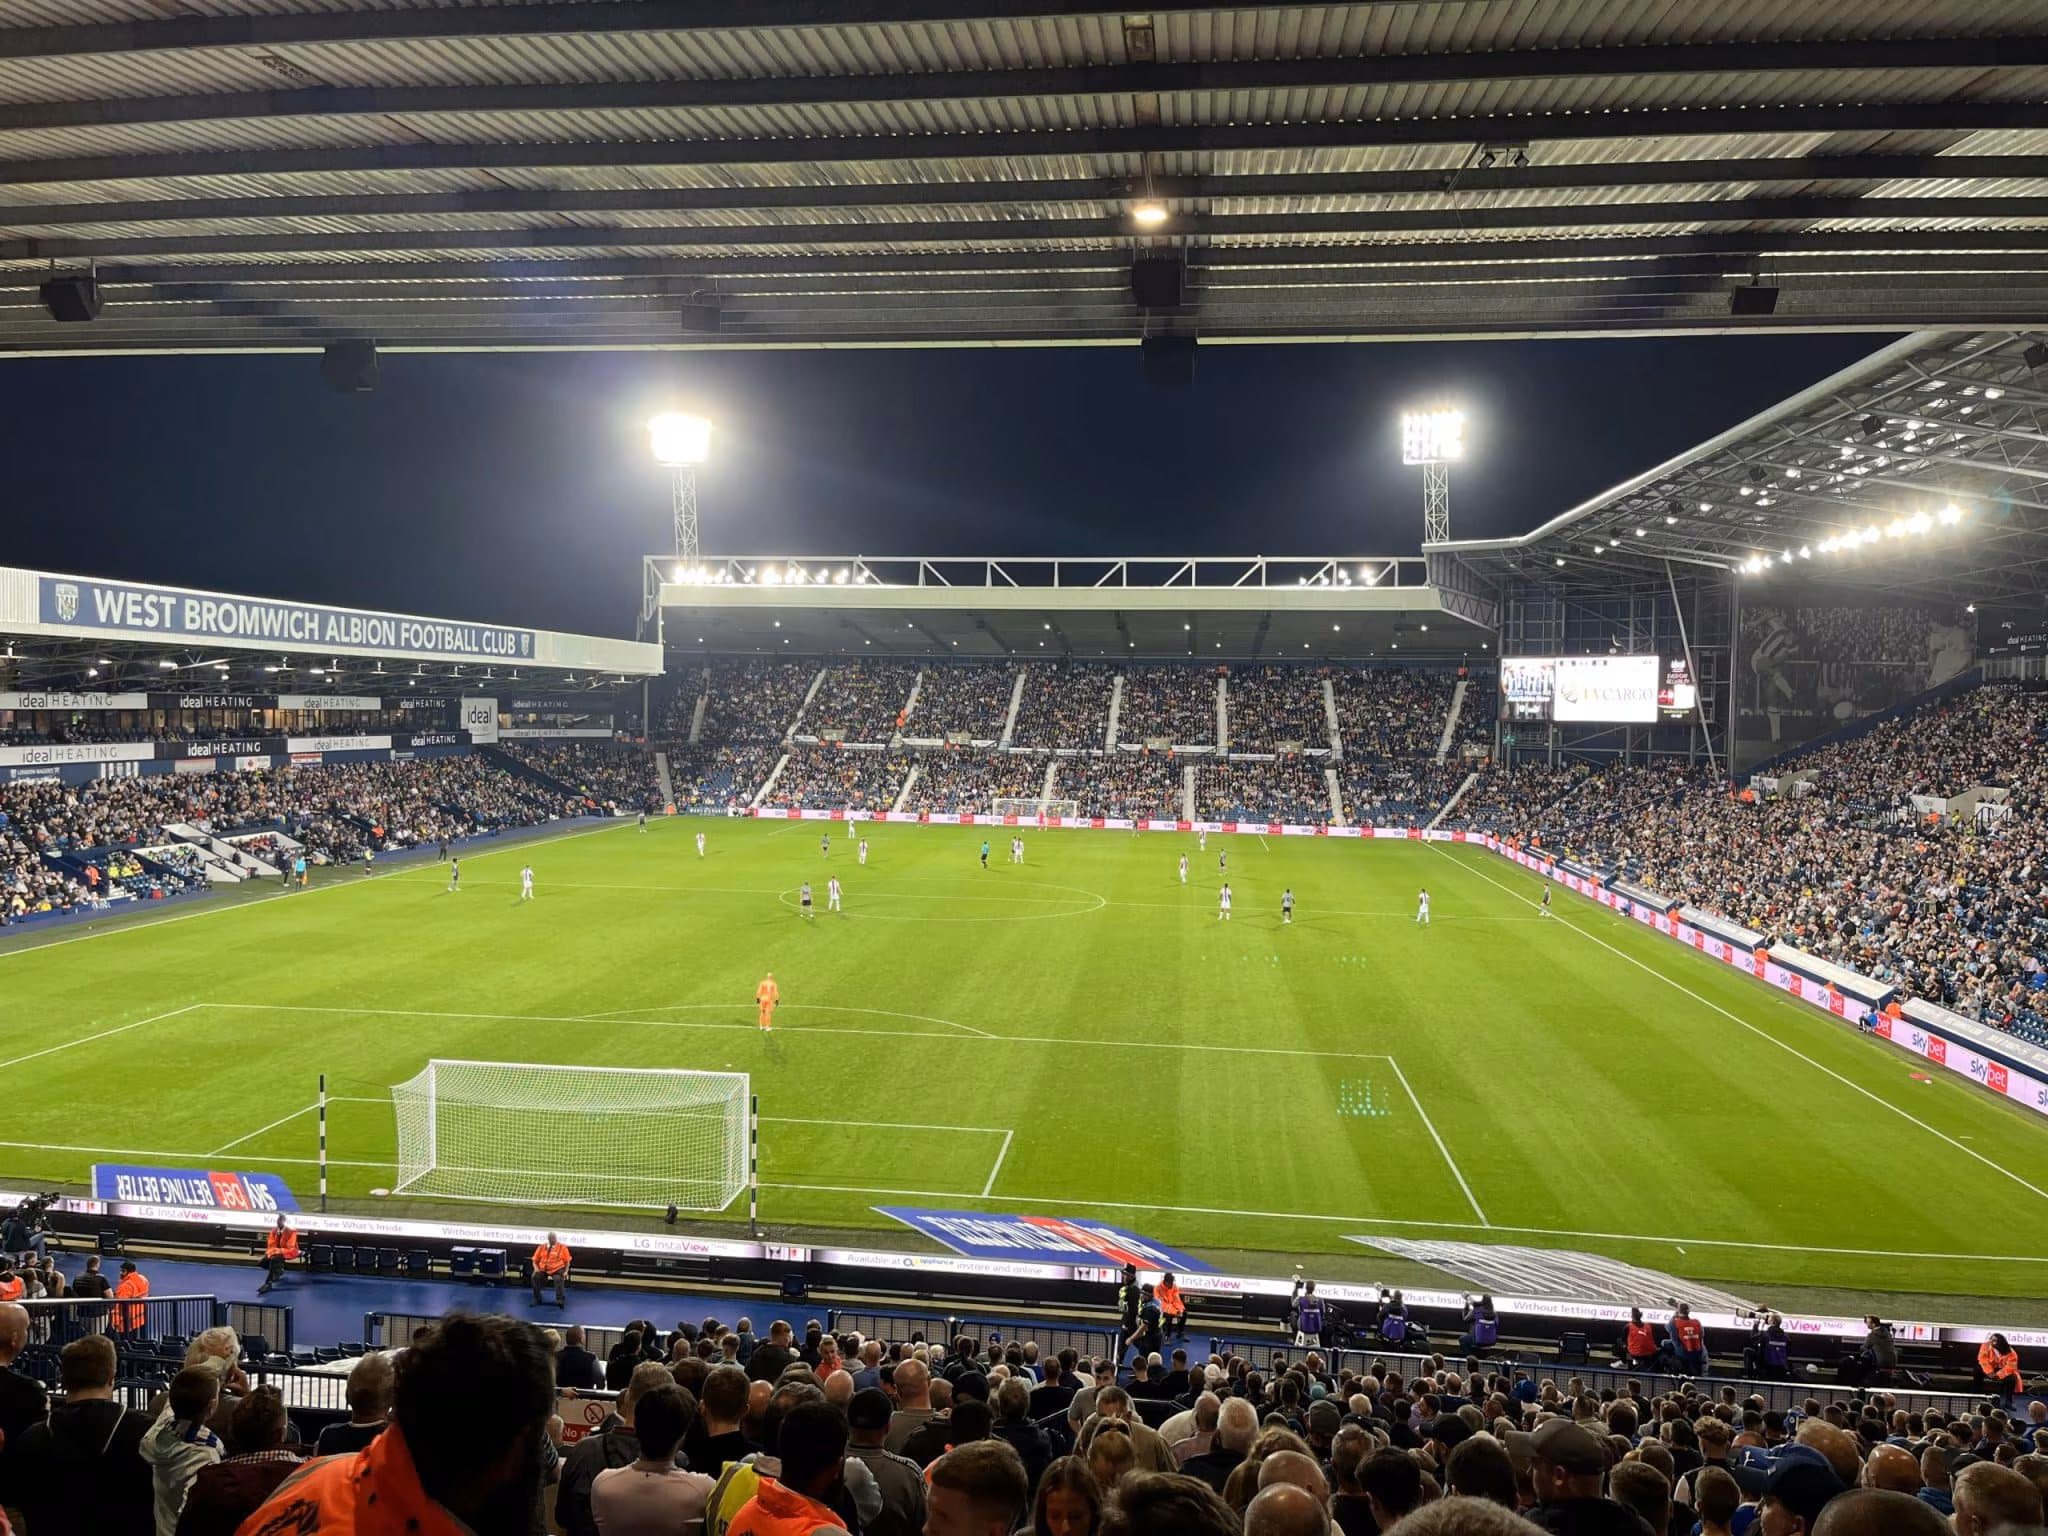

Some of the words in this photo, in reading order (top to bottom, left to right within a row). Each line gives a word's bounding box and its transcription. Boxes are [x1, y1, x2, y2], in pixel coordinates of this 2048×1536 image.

[93, 588, 176, 628] WEST
[184, 598, 319, 641] BROMWICH
[325, 615, 395, 647] ALBION
[401, 622, 479, 652] FOOTBALL
[482, 630, 516, 655] CLUB
[19, 692, 48, 708] ideal
[51, 695, 113, 707] HEATING
[180, 695, 203, 709] ideal
[205, 696, 252, 707] HEATING
[303, 697, 322, 709] ideal
[324, 698, 360, 708] HEATING
[400, 698, 415, 709] ideal
[415, 699, 445, 708] HEATING
[467, 705, 492, 724] ideal
[187, 742, 211, 757] ideal
[213, 742, 261, 754] HEATING
[314, 740, 331, 750] ideal
[333, 738, 370, 749] HEATING
[411, 736, 425, 747] ideal
[426, 735, 456, 745] HEATING
[23, 748, 52, 763] ideal
[55, 746, 118, 760] HEATING
[1818, 990, 1829, 1007] sky
[1830, 994, 1843, 1012] bet
[1878, 1014, 1891, 1033] bet
[1912, 1032, 1927, 1052] sky
[1928, 1039, 1945, 1057] bet
[1970, 1058, 1988, 1081] sky
[1988, 1066, 2006, 1087] bet
[116, 1174, 159, 1201] BETTER
[160, 1176, 215, 1207] BETTING
[215, 1181, 248, 1210] bet
[242, 1175, 278, 1211] sky
[138, 1207, 154, 1217] LG
[158, 1208, 209, 1221] InstaView
[442, 1227, 481, 1237] Without
[634, 1239, 650, 1249] LG
[654, 1240, 709, 1253] InstaView
[847, 1254, 889, 1265] Available
[891, 1256, 901, 1265] at
[956, 1262, 990, 1272] instore
[992, 1263, 1011, 1273] and
[1012, 1264, 1043, 1275] online
[1181, 1275, 1241, 1290] InstaView
[1315, 1287, 1340, 1297] nock
[1436, 1296, 1465, 1305] Insid
[1513, 1300, 1558, 1312] Without
[1560, 1304, 1597, 1317] letting
[1600, 1308, 1619, 1320] any
[1647, 1312, 1662, 1321] air
[2035, 1335, 2047, 1344] at
[563, 1427, 577, 1438] No
